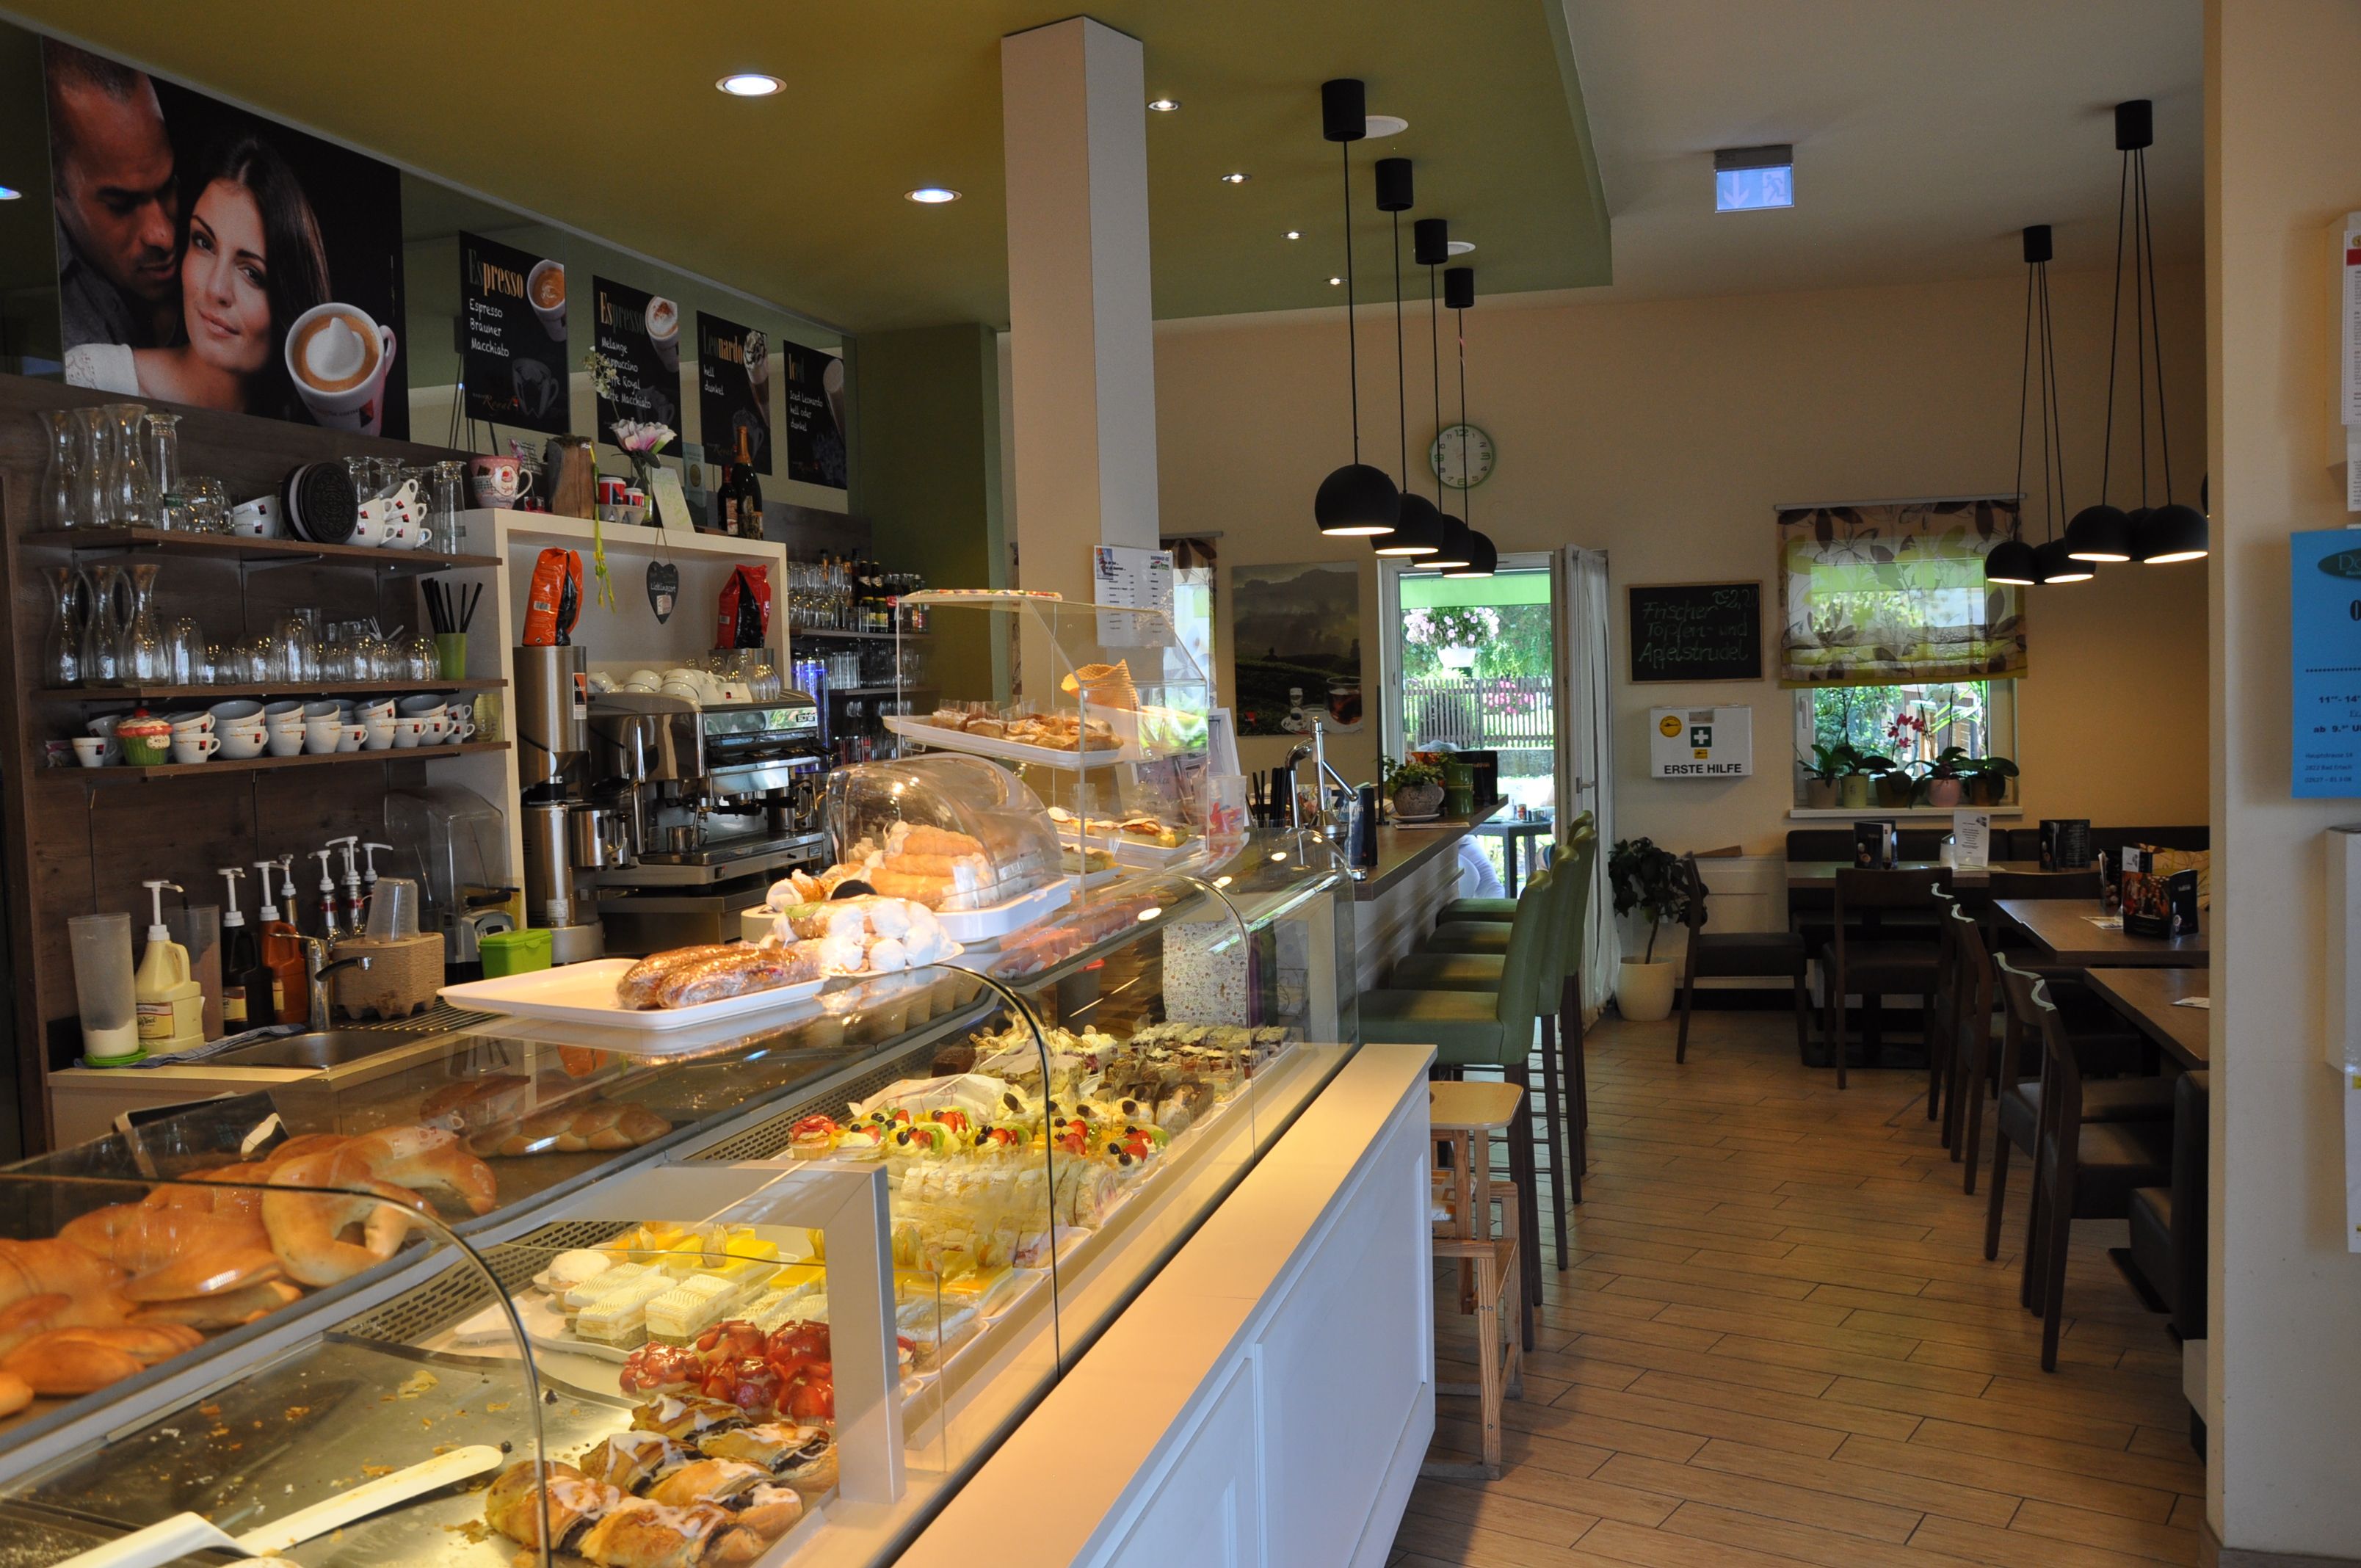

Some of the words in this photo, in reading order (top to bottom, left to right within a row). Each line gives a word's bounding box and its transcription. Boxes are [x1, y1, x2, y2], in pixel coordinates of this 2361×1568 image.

[468, 248, 524, 300] Espresso
[469, 298, 504, 320] Espresso
[599, 291, 645, 335] Espresso
[470, 317, 502, 337] Brauner
[471, 337, 510, 357] Macchiato
[601, 336, 628, 357] Melange
[703, 364, 715, 378] hell
[623, 375, 641, 396] Royal
[704, 379, 725, 396] dunkel
[621, 393, 652, 410] Macchiato
[1642, 600, 1719, 622] Frischer
[1719, 611, 1748, 637] und
[1639, 638, 1749, 669] Apfelstrudel
[1664, 764, 1704, 774] ERSTE
[1707, 763, 1742, 773] HILFE
